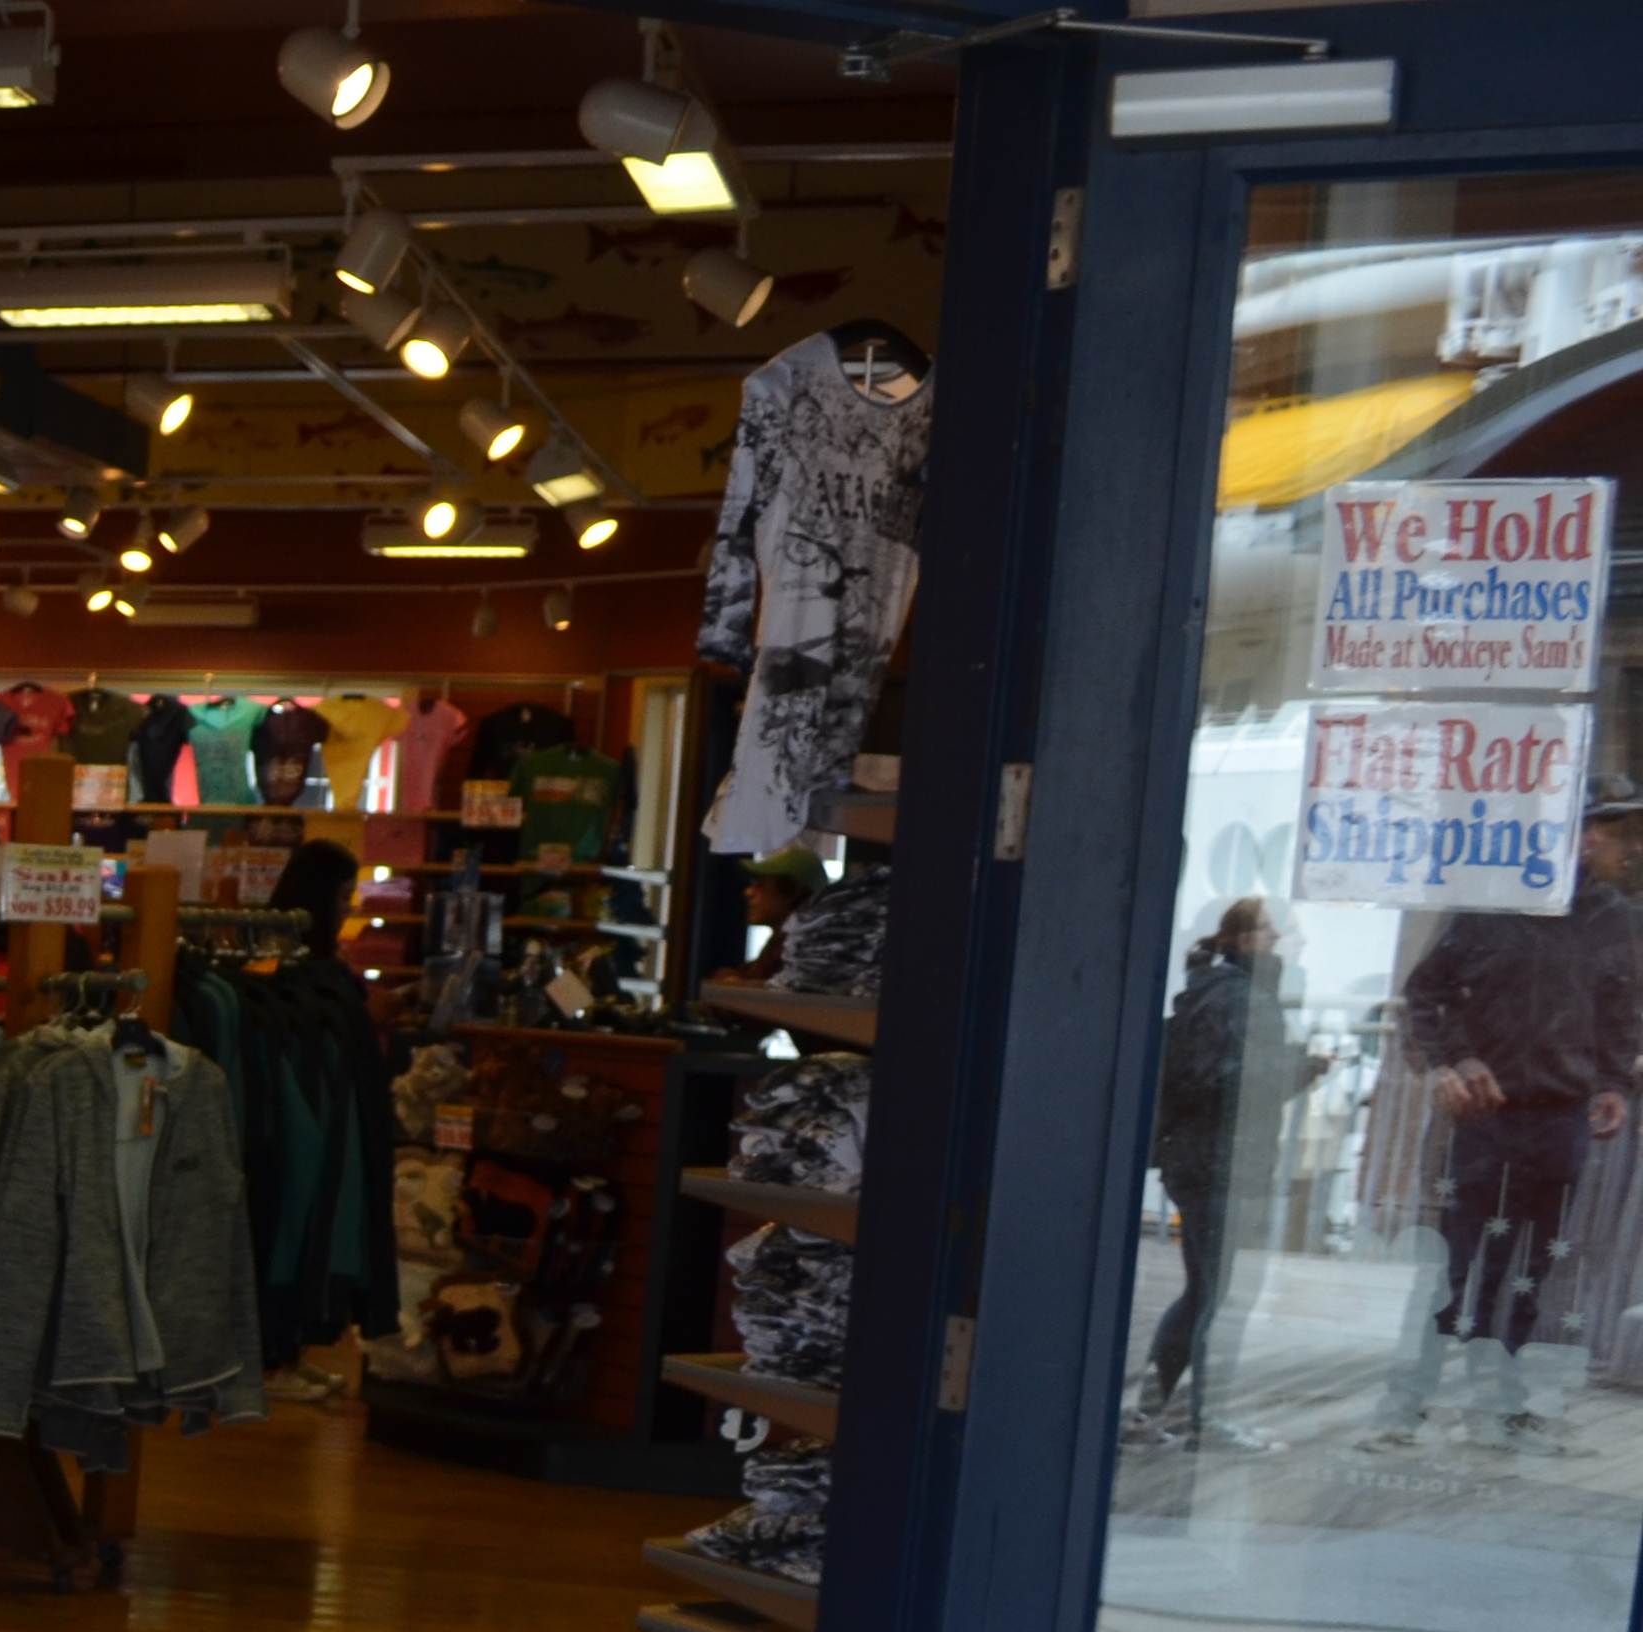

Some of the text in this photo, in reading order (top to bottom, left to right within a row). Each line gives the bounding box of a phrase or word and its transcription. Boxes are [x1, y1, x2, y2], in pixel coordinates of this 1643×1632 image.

[1336, 492, 1593, 563] We Hold
[1325, 565, 1590, 622] All Purchases
[1322, 624, 1584, 681] Made at Sockeye Sam's
[1309, 714, 1571, 794] Flat Rate
[1305, 797, 1565, 889] Shipping
